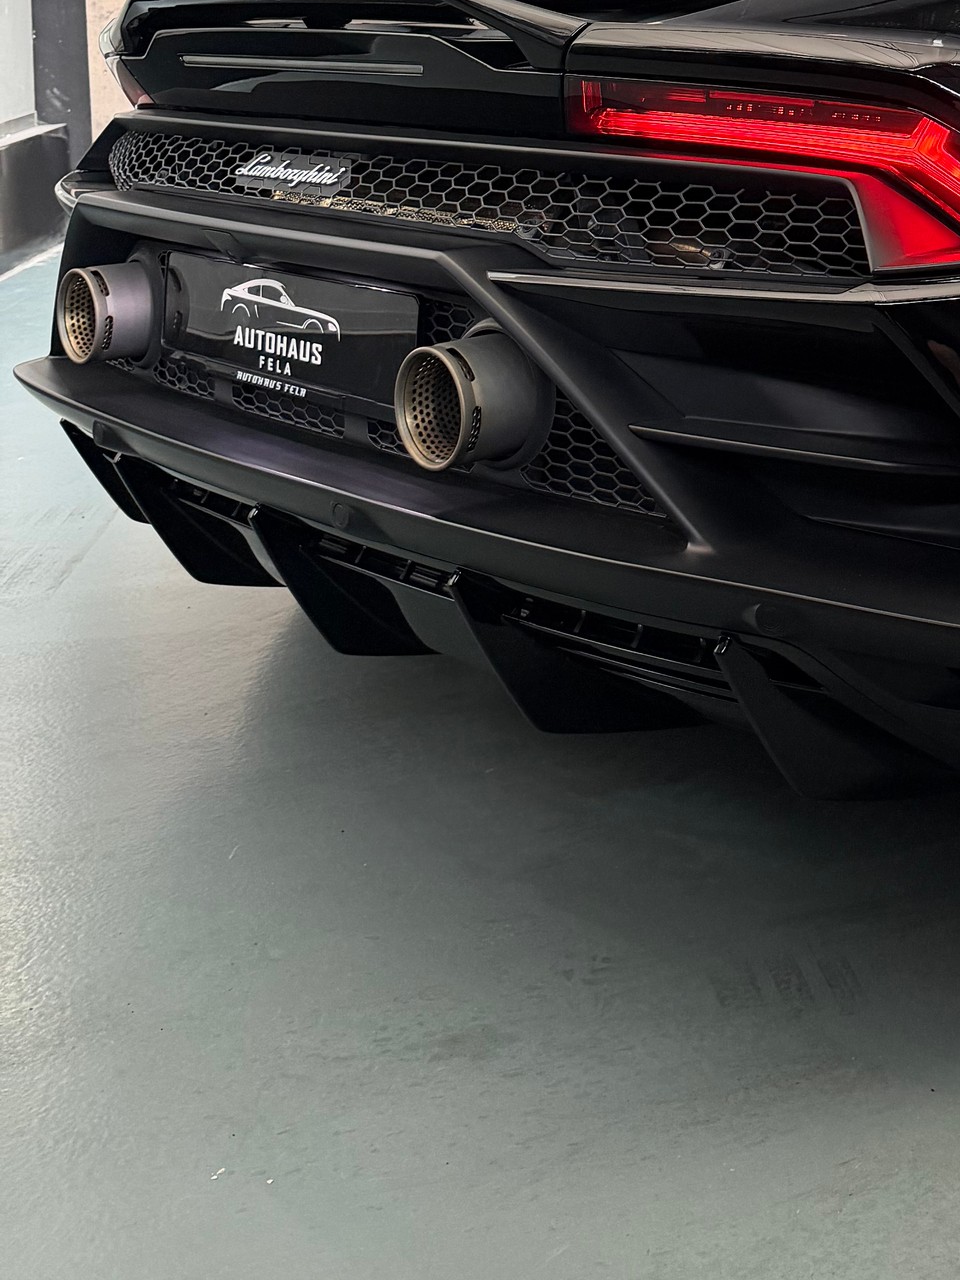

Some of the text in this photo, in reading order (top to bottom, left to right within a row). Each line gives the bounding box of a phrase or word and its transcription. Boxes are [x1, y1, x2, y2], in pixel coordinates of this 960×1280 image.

[234, 153, 346, 187] Lamborghini
[233, 325, 323, 366] AUTOHAUS
[259, 355, 292, 376] FELA
[236, 370, 307, 398] AUTOHAUS FELA
